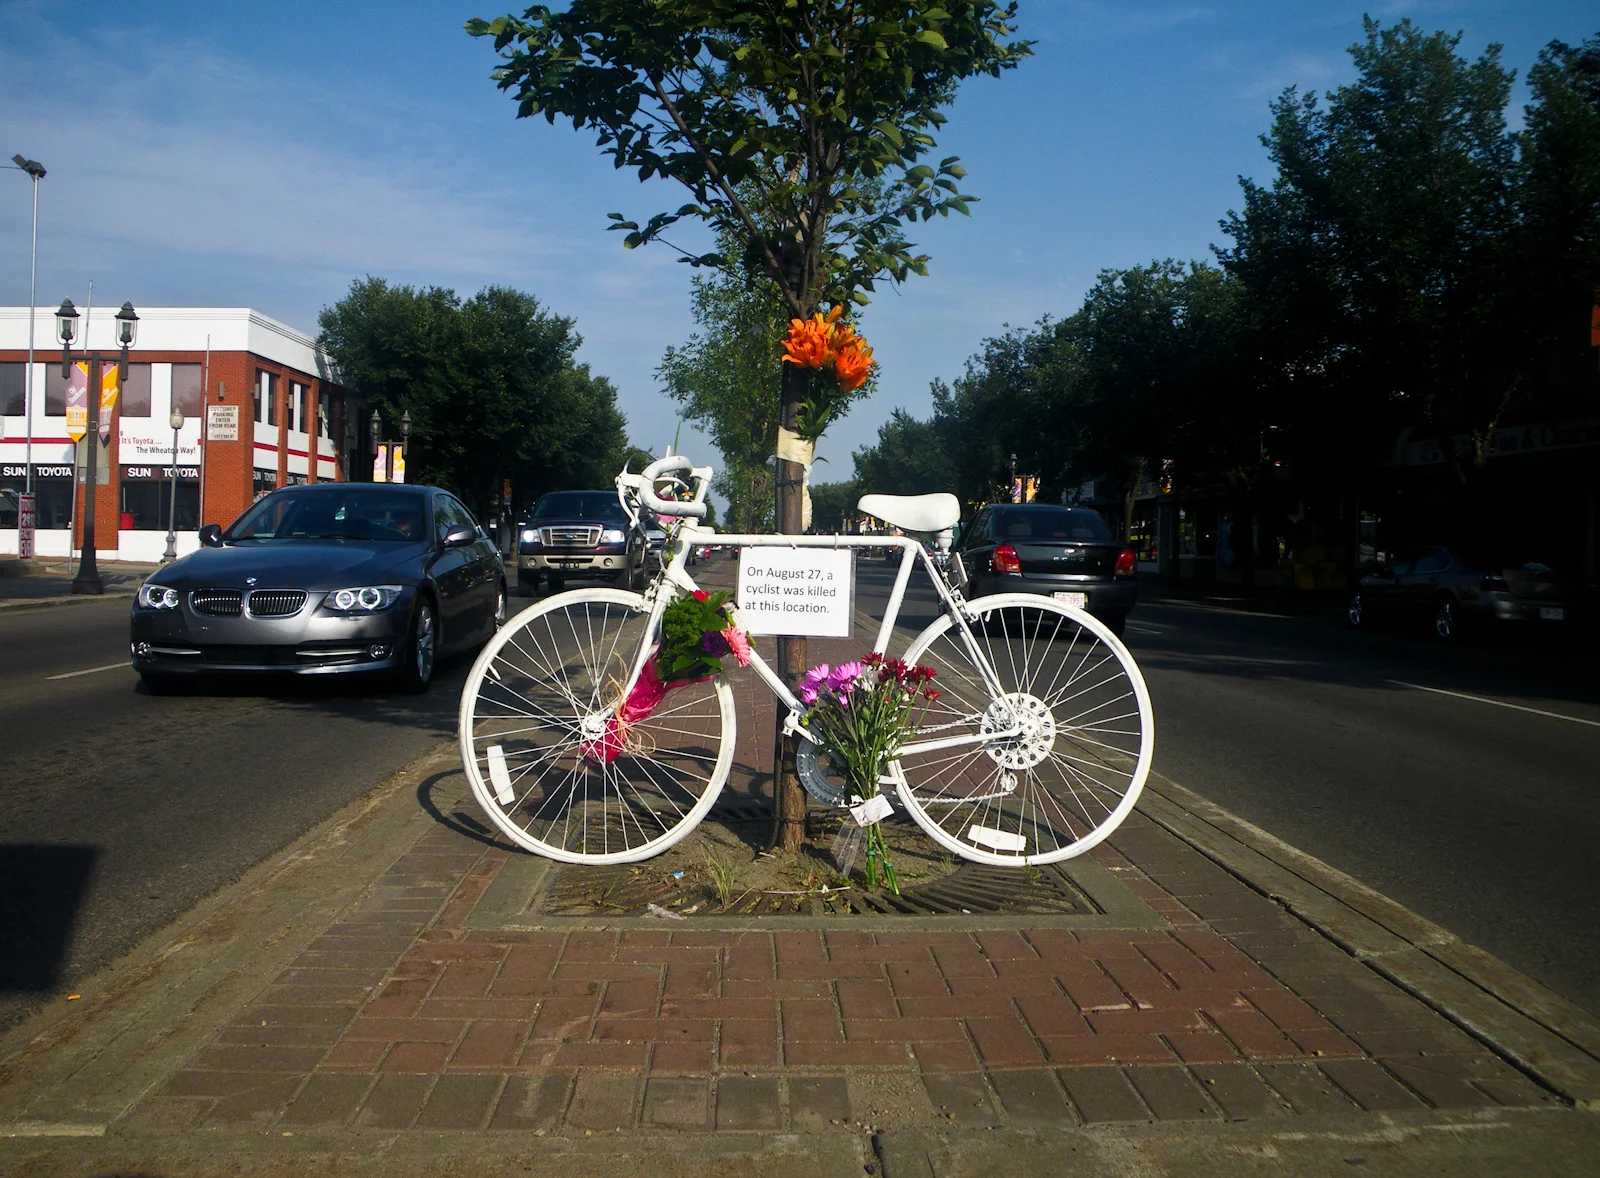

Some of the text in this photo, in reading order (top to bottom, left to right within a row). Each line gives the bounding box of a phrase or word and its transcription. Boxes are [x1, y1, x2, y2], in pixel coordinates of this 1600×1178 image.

[132, 437, 154, 446] Toyota
[136, 446, 148, 454] The
[180, 446, 196, 455] Way!
[2, 466, 72, 477] SUN TOYOTA
[128, 467, 199, 478] SUN TOYOTA
[747, 566, 833, 581] On August 27, a
[746, 583, 837, 597] cyclist was killed
[745, 600, 830, 614] at this location.
